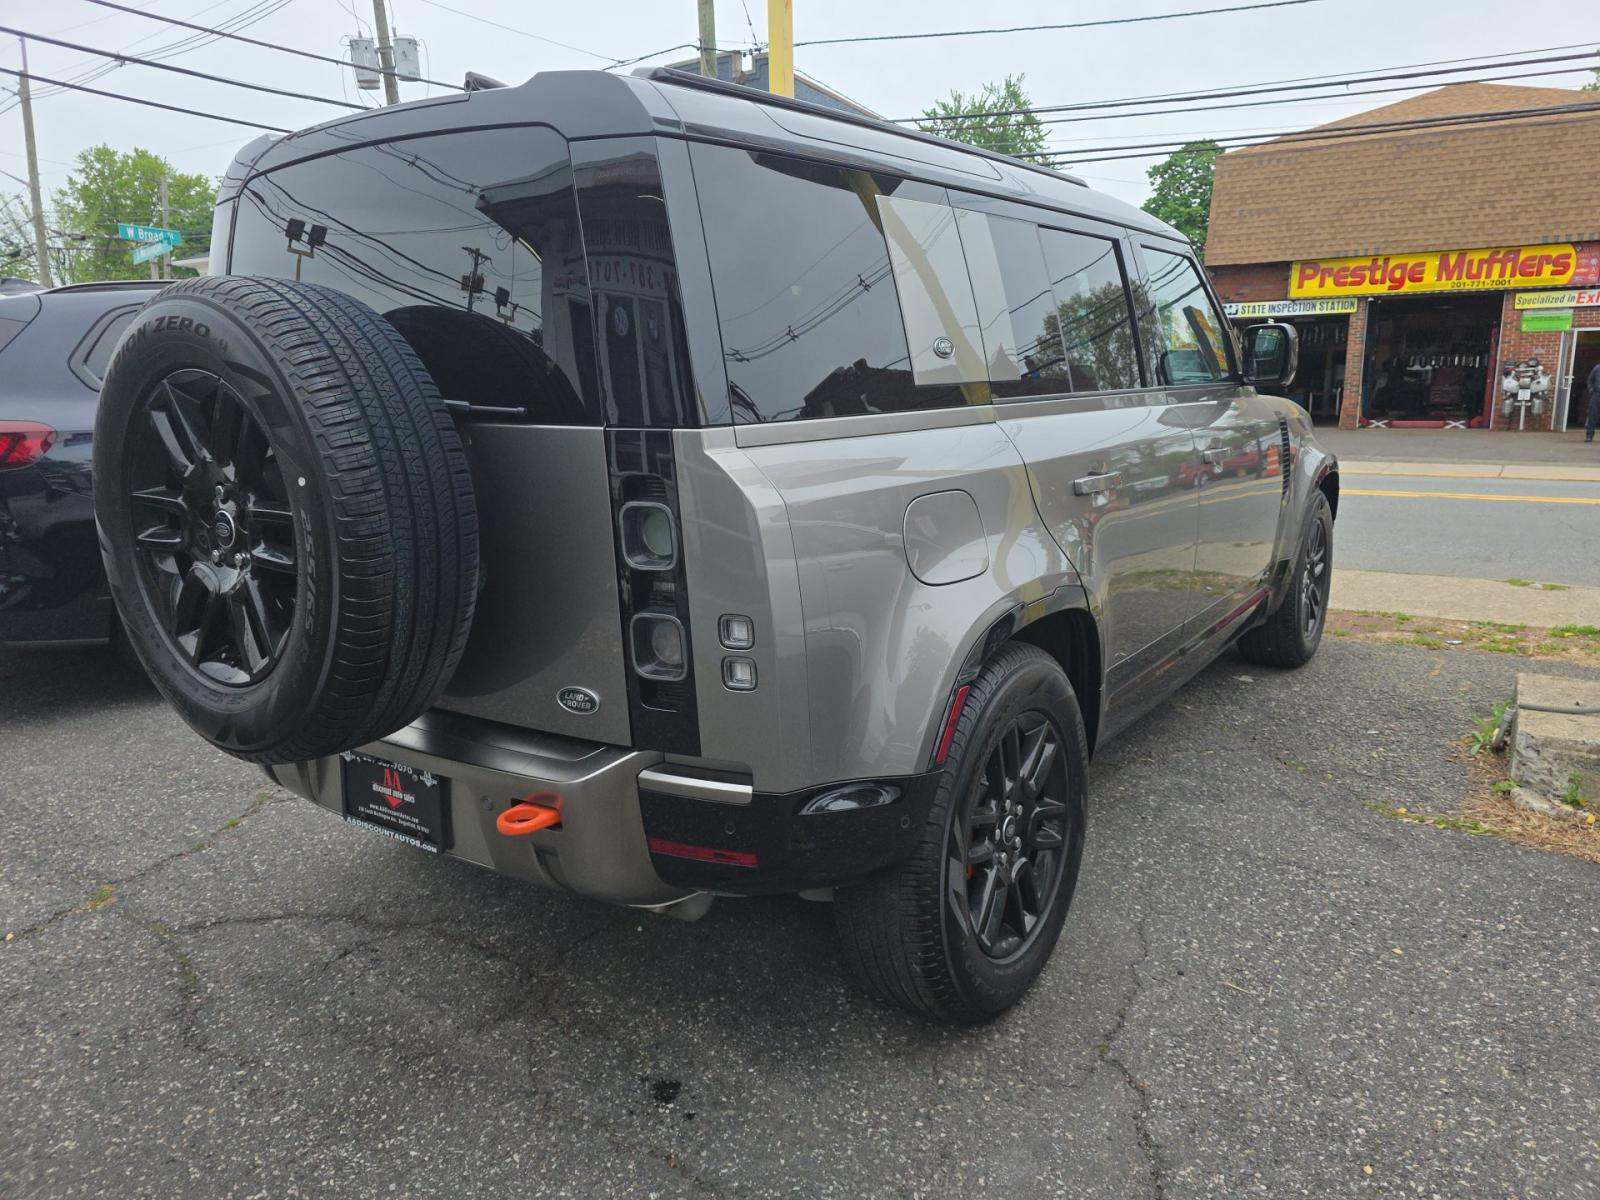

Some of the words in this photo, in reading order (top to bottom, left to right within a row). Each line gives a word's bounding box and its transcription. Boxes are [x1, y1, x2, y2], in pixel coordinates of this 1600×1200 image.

[126, 227, 135, 238] W
[138, 229, 164, 241] Broad
[1298, 257, 1427, 290] Prestige
[1436, 249, 1573, 282] Mufflers
[1450, 279, 1512, 289] 201-771-7001
[1516, 294, 1565, 306] Specialized
[1567, 294, 1576, 302] in
[1240, 304, 1266, 316] STATE
[1268, 301, 1317, 314] INSPECTION
[1319, 299, 1356, 312] STATION
[153, 315, 210, 337] ZERO
[565, 692, 584, 701] LAND
[567, 700, 591, 709] ROVER
